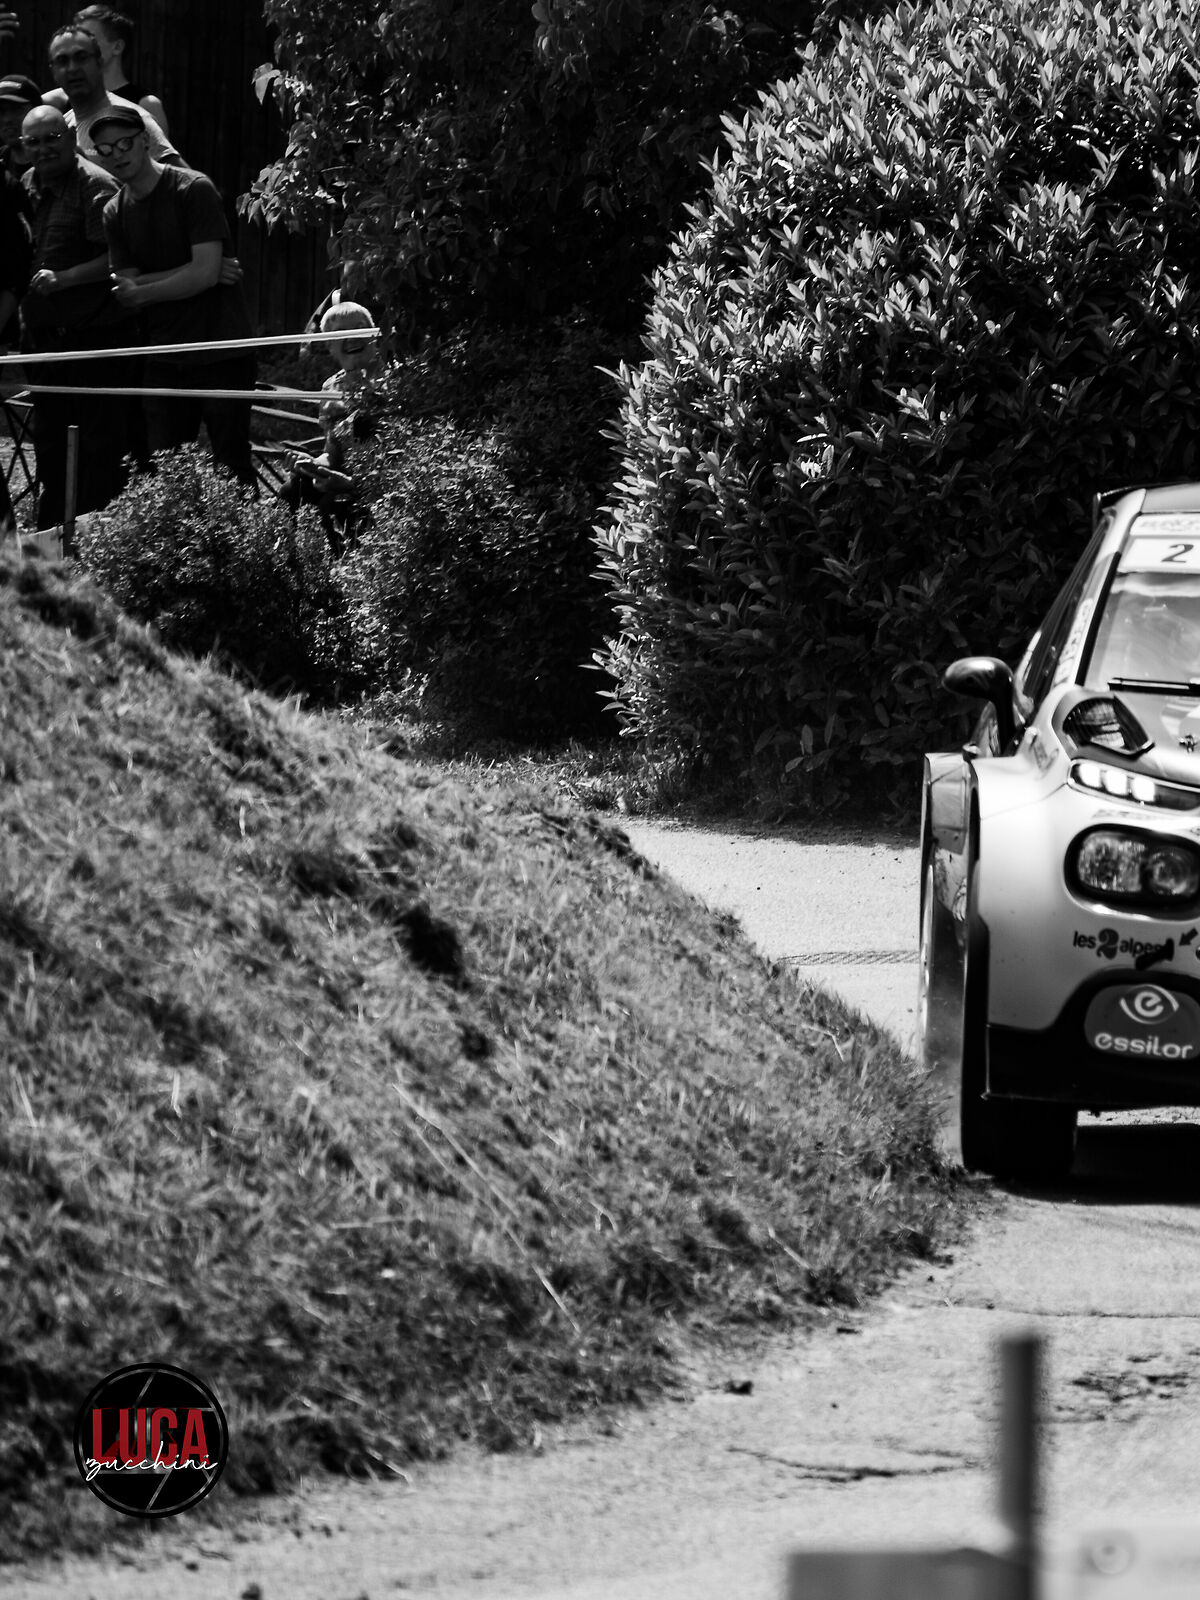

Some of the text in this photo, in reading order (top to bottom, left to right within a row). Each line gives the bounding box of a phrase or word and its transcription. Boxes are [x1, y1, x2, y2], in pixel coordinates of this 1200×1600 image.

[1161, 543, 1195, 563] 2
[1073, 931, 1097, 949] les
[1096, 927, 1119, 960] 2
[1094, 1032, 1194, 1060] essilor
